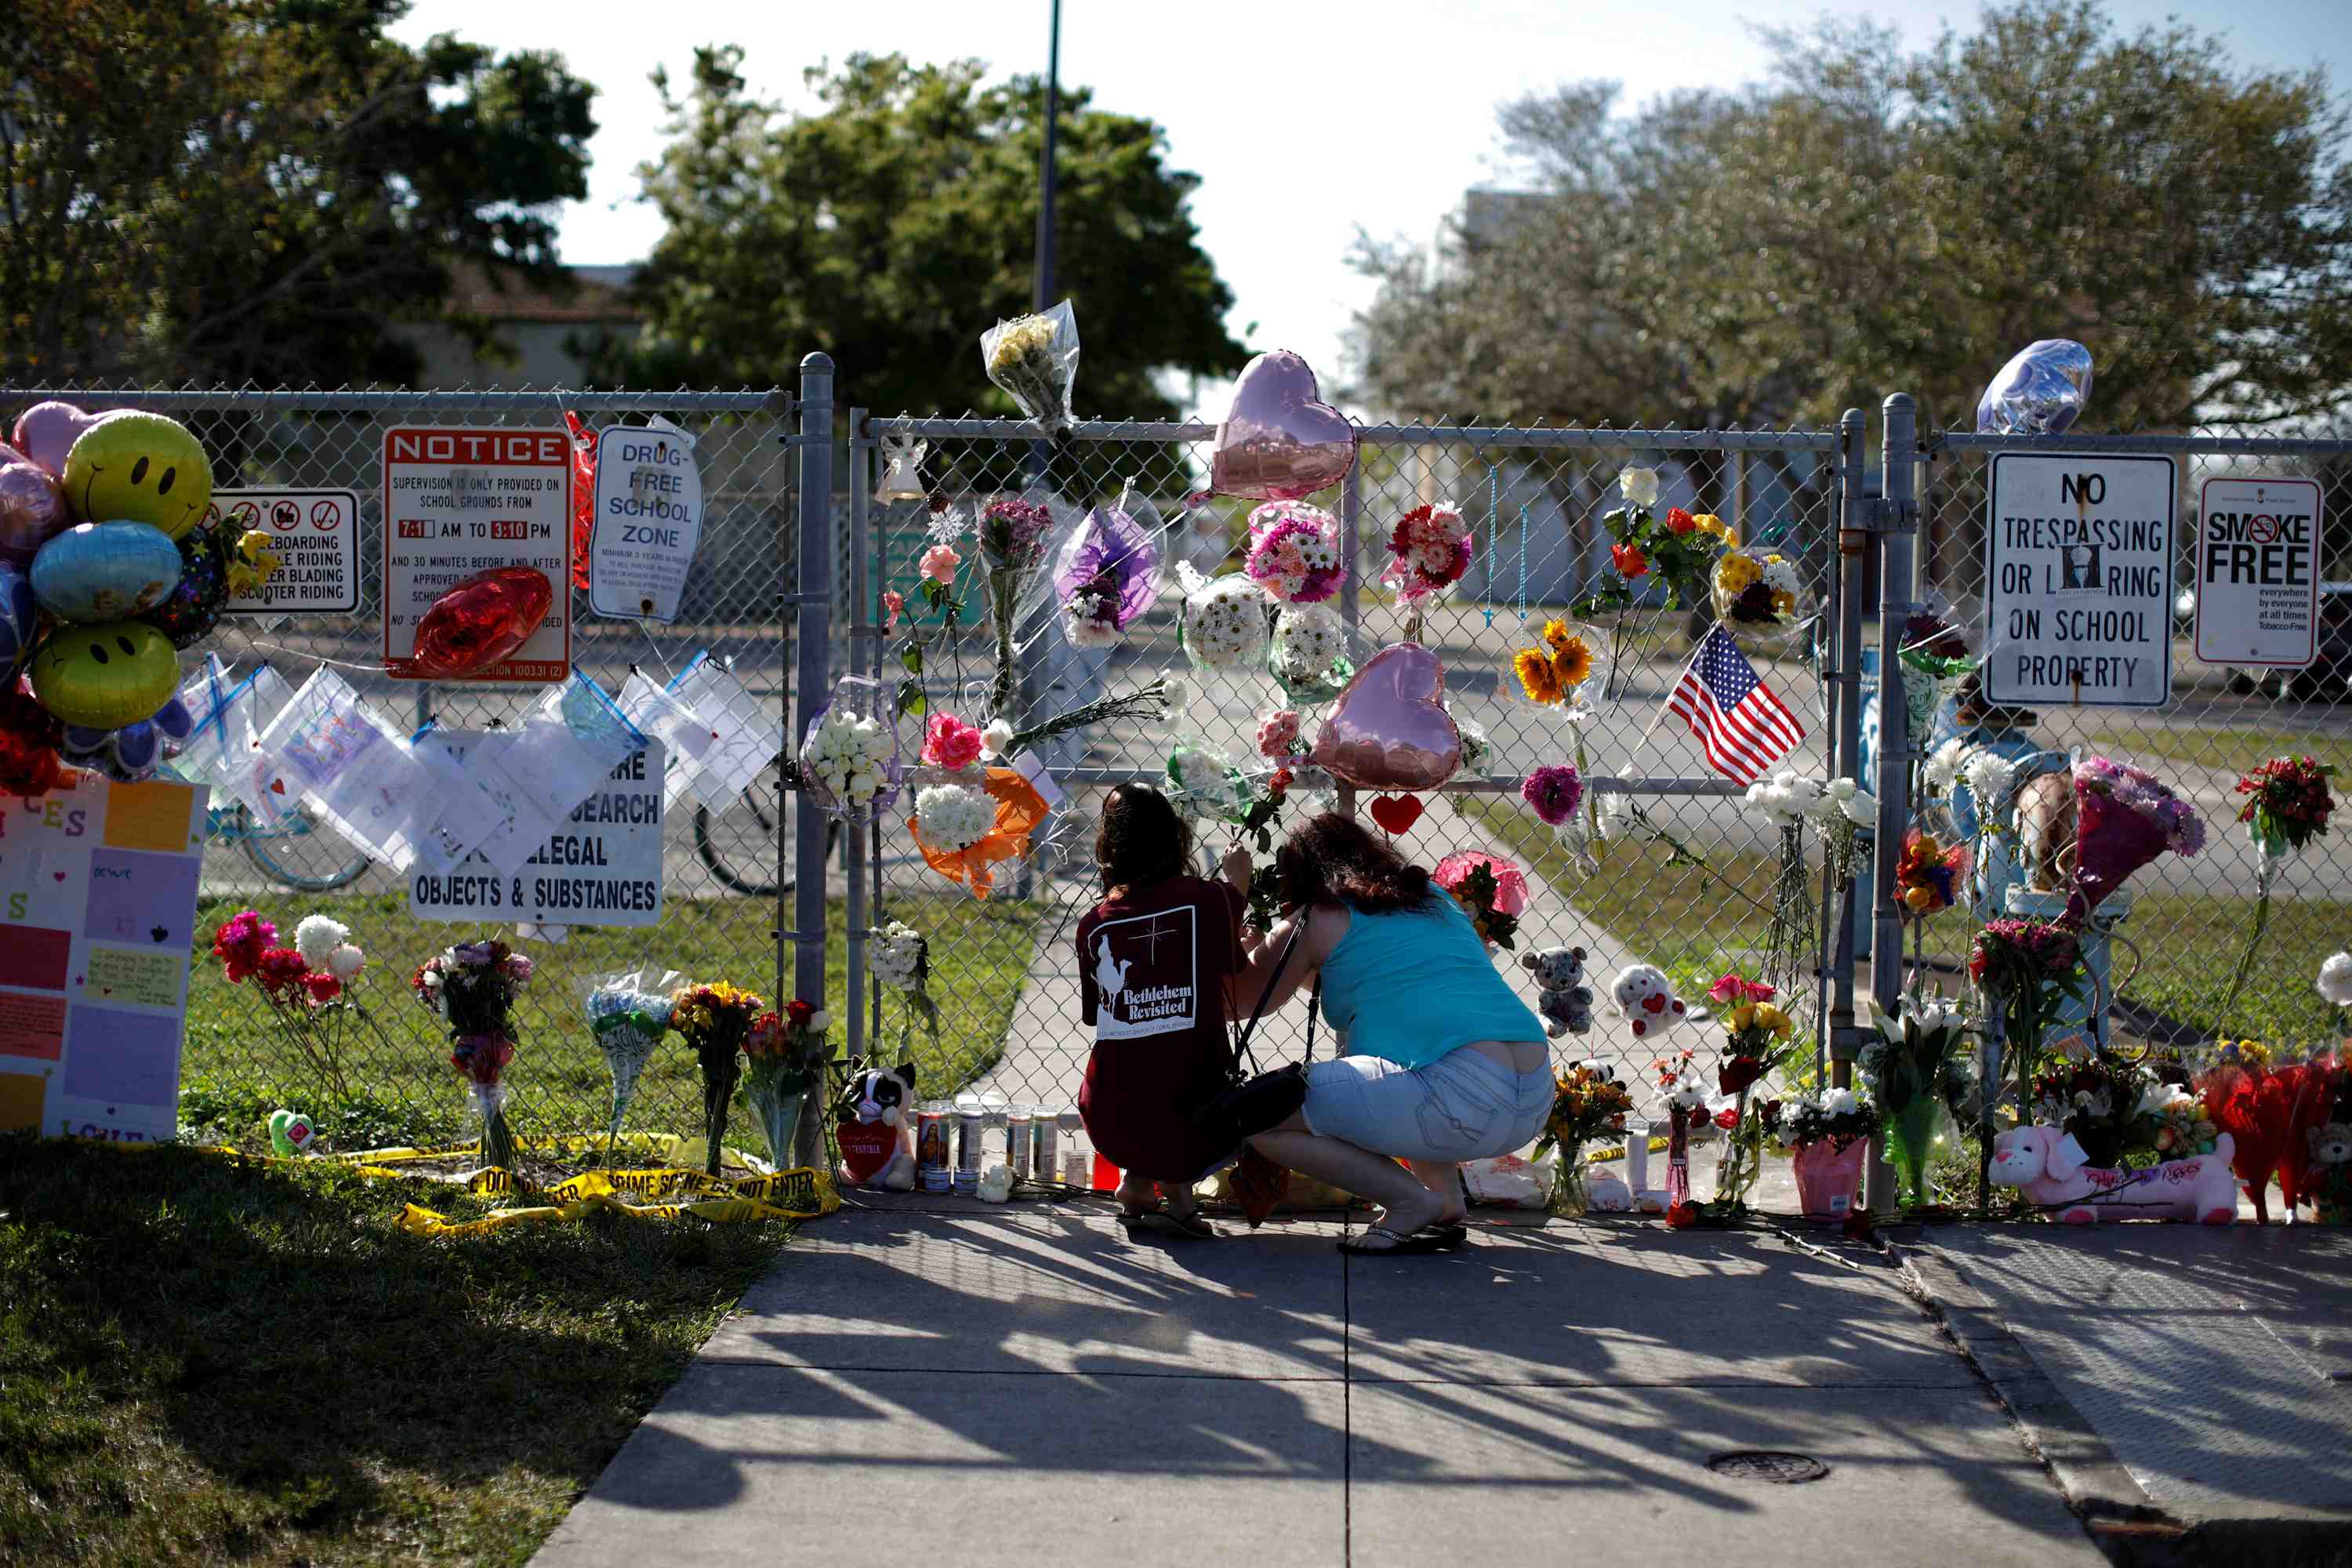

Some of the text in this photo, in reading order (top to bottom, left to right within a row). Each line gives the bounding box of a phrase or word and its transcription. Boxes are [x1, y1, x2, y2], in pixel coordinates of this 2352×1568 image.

[394, 436, 561, 461] NOTICE
[622, 445, 688, 466] DRUG-
[394, 477, 559, 491] SUPERVISION IS ONLY PROVIDED ON
[630, 472, 682, 493] FREE
[2062, 474, 2106, 504] NO
[420, 495, 532, 509] SCHOOL GROUNDS FROM
[609, 497, 691, 523] SCHOOL
[441, 523, 462, 537] AM
[470, 523, 486, 537] TO
[495, 522, 524, 538] 3:10
[531, 524, 550, 538] PM
[622, 526, 679, 547] ZONE
[2004, 517, 2162, 552] TRESPASSING
[298, 553, 343, 566] RIDING
[391, 557, 561, 569] AND 30 MINUTES BEFORE AND AFTER
[2206, 544, 2309, 585] FREE
[290, 569, 343, 583] BLADING
[413, 575, 459, 585] APPROVED
[2002, 563, 2160, 597] OR LRING
[238, 586, 343, 599] SCOOTER RIDING
[2259, 589, 2308, 598] everywhere
[2259, 599, 2308, 609] by everyone
[391, 615, 403, 625] NO
[2009, 608, 2150, 642] ON SCHOOL
[2270, 611, 2280, 619] all
[2283, 611, 2307, 620] times
[550, 665, 562, 678] (2)
[2018, 655, 2139, 688] PROPERTY
[527, 836, 608, 866] LEGAL
[416, 875, 655, 911] OBJECTS & SUBSTANCES
[1123, 985, 1192, 1004] Bethlehem
[1129, 998, 1185, 1020] Revisited
[737, 1179, 767, 1198] NOT
[770, 1171, 815, 1197] ENTER
